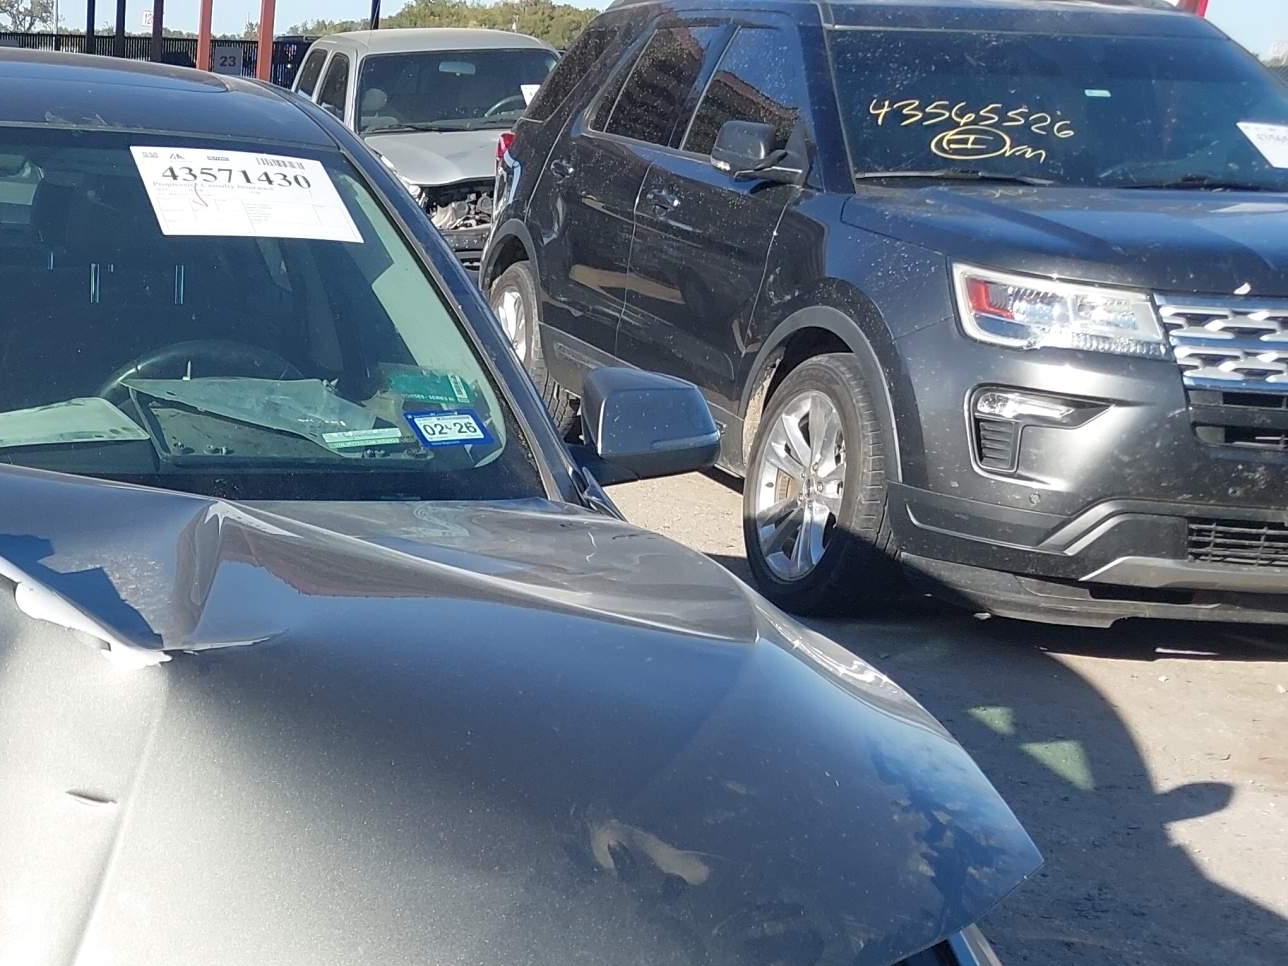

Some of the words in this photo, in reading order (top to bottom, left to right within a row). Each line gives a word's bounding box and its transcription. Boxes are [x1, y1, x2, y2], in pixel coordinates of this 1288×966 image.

[219, 56, 236, 67] 23
[869, 99, 1075, 138] 43565526
[161, 166, 312, 189] 43571430
